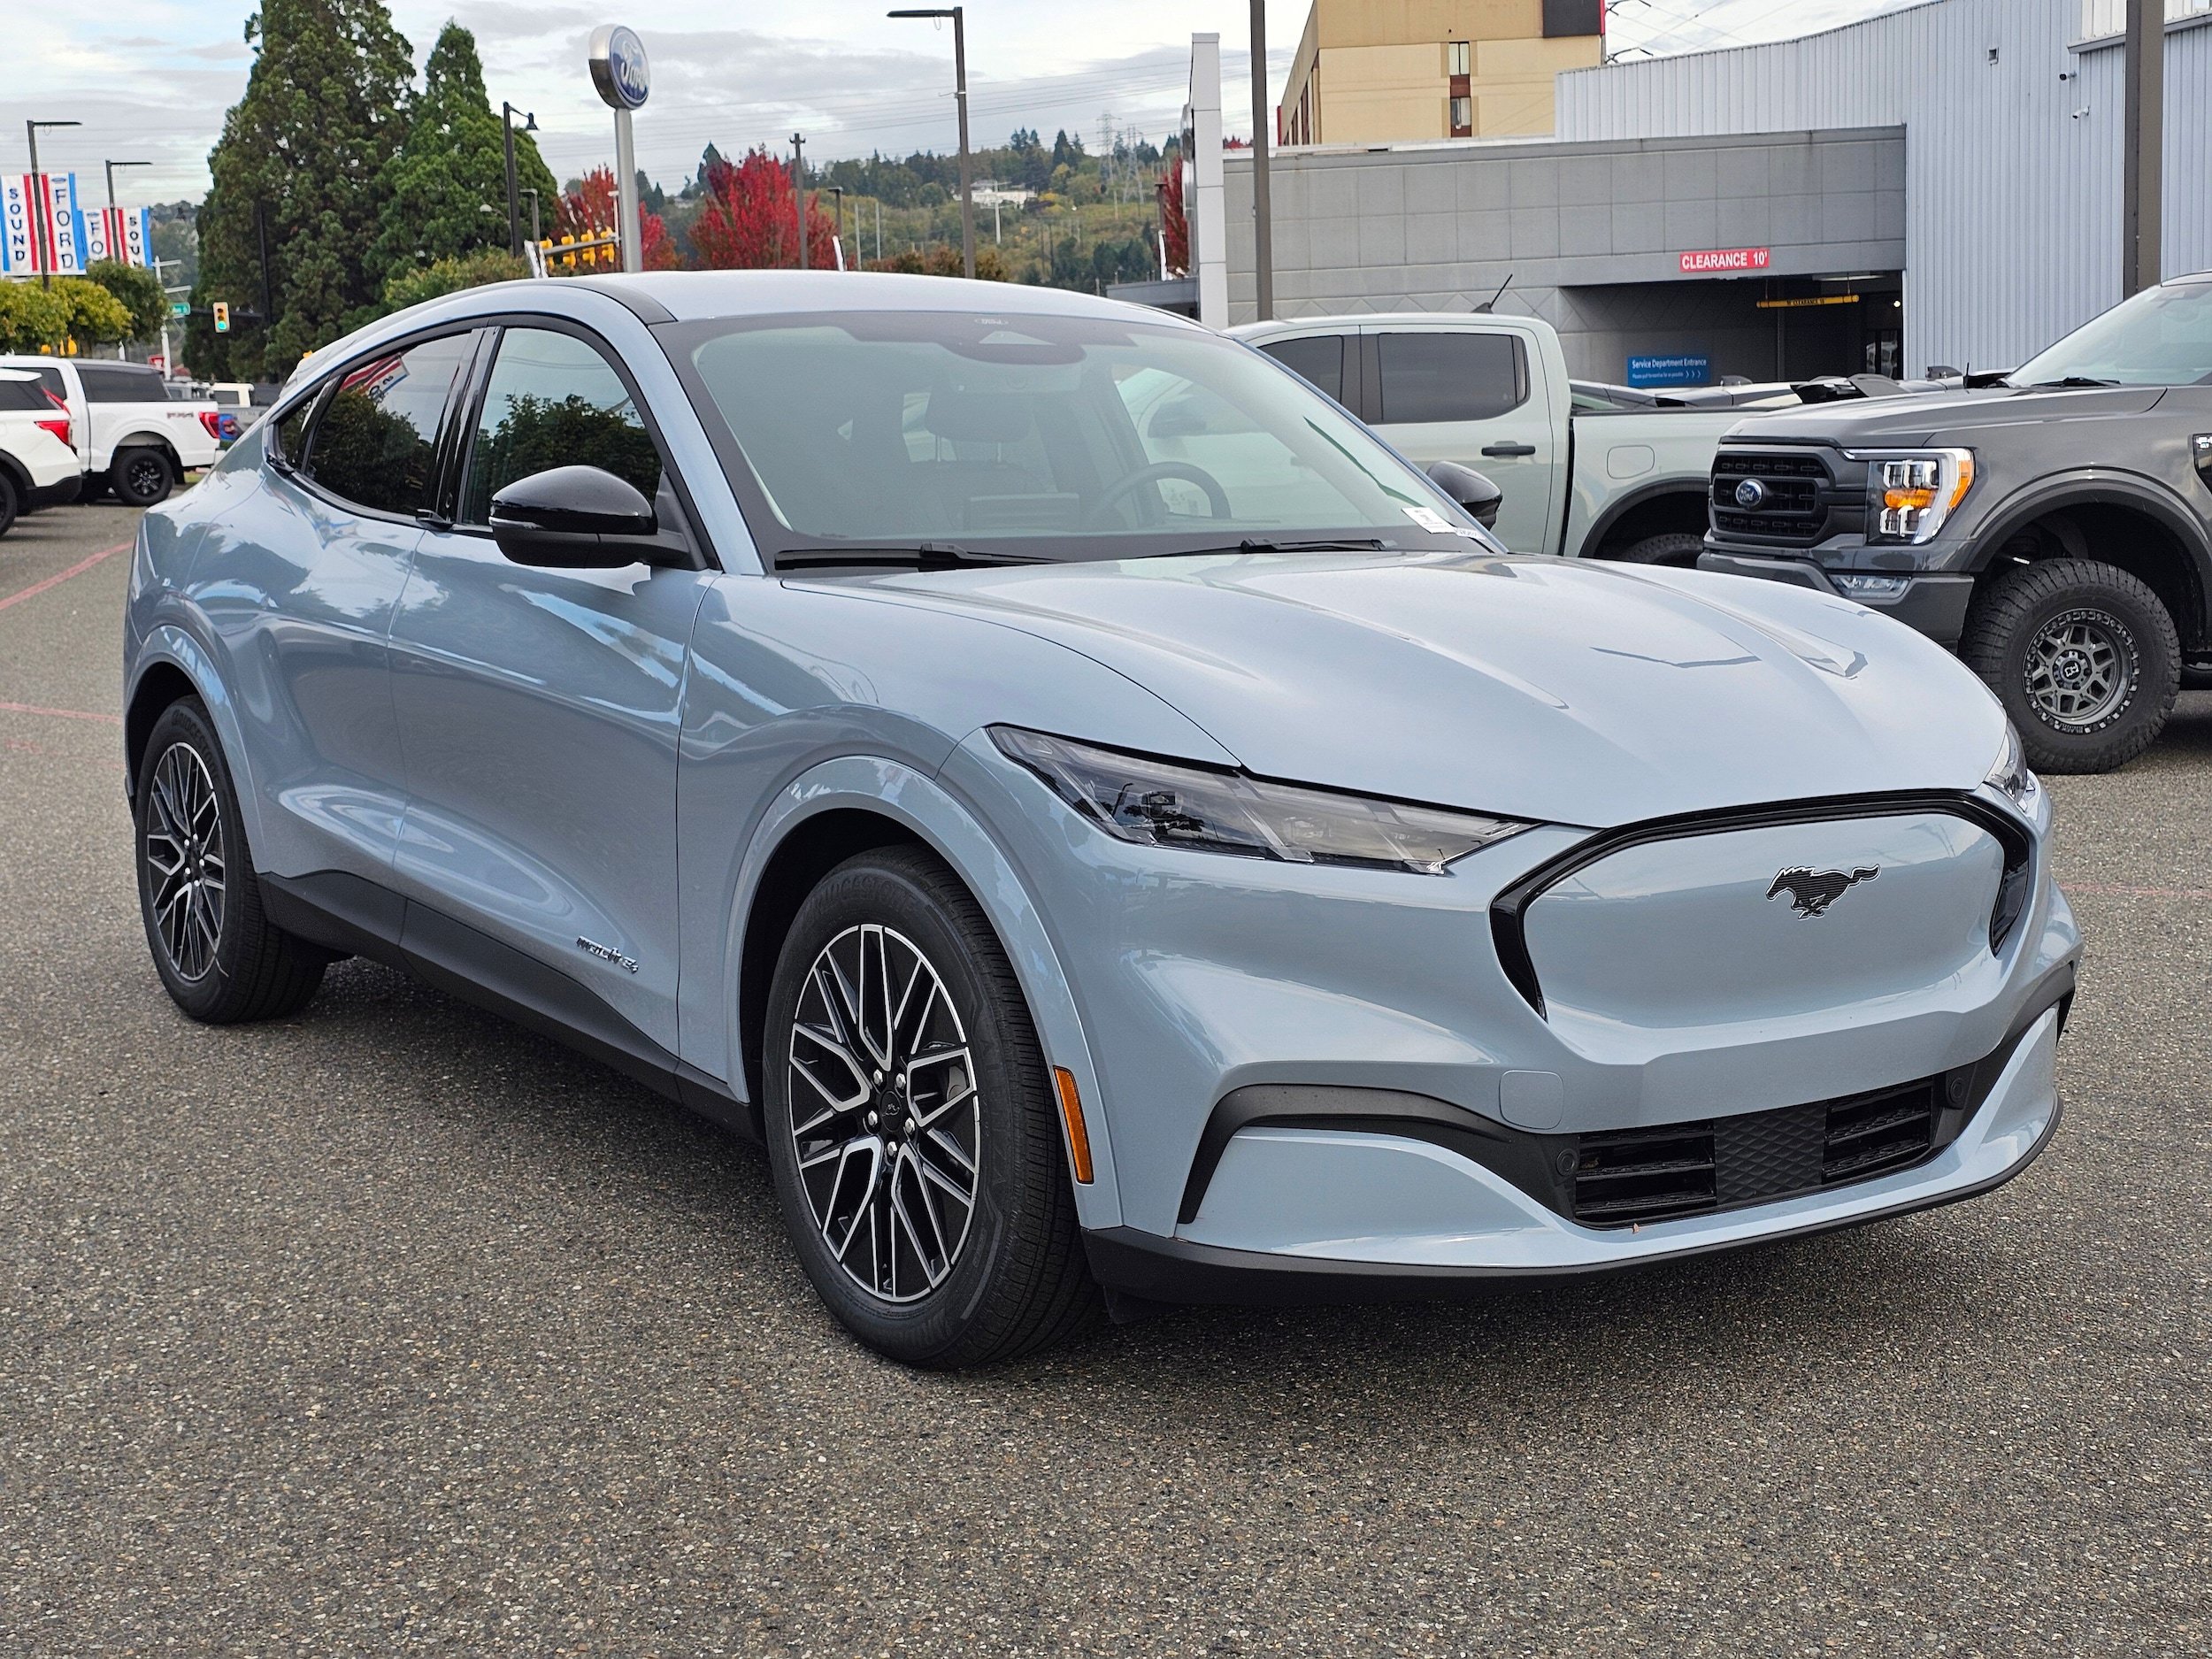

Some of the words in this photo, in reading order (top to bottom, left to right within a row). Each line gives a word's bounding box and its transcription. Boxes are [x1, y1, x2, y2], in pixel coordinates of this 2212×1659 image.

[620, 40, 647, 93] Ford
[9, 188, 25, 261] SOUND
[55, 188, 73, 269] FORD
[90, 221, 104, 255] FO
[129, 216, 141, 265] SOU
[1682, 252, 1747, 269] CLEARANCE
[1753, 250, 1768, 265] 10'
[1632, 358, 1651, 369] Service
[1652, 358, 1683, 370] Department
[1684, 357, 1707, 366] Entrance
